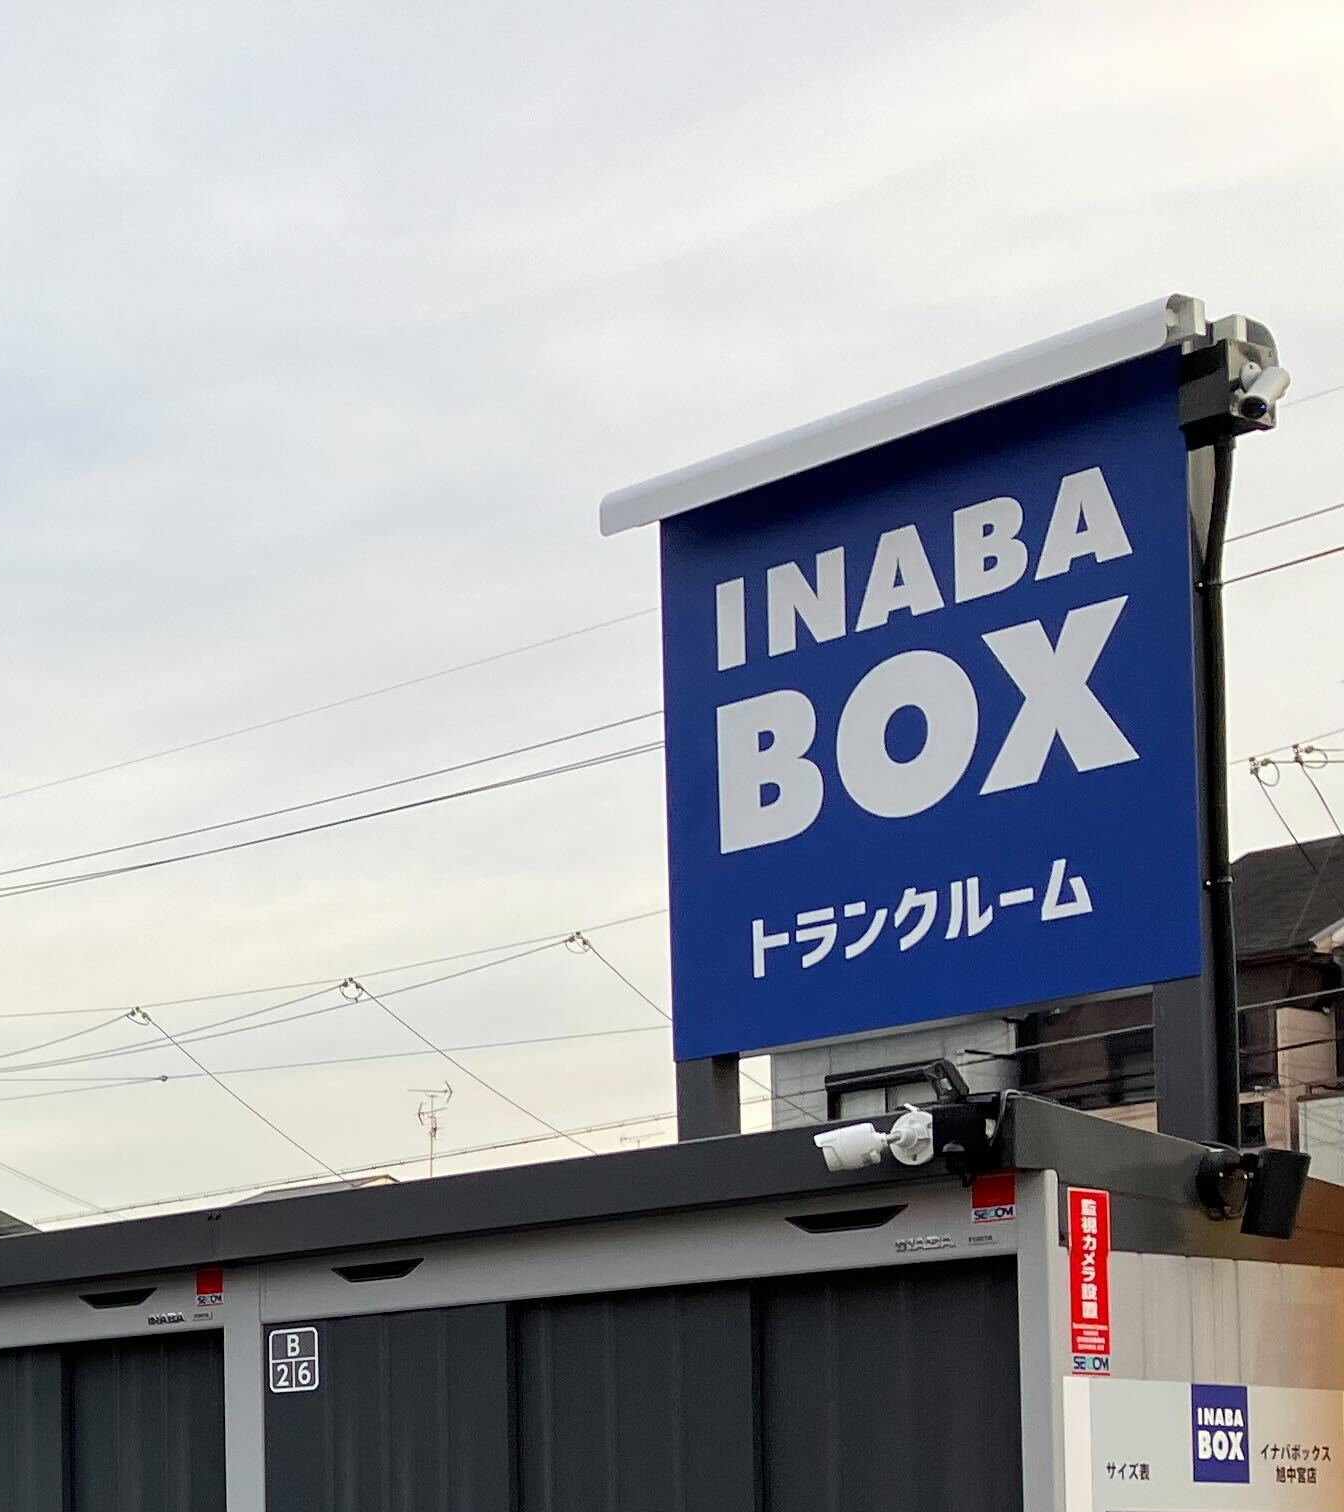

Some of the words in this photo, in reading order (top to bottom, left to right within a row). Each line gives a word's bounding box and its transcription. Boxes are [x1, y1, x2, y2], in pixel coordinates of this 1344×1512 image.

[715, 466, 1133, 672] INABA
[717, 595, 1140, 855] BOX
[752, 858, 1094, 979] トランクルーム
[974, 1205, 1014, 1220] SECOM
[286, 1333, 300, 1357] B
[276, 1362, 311, 1387] 26
[1073, 1356, 1110, 1371] SECOM
[1197, 1407, 1244, 1428] INABA
[1197, 1430, 1246, 1461] BOX
[1260, 1443, 1332, 1464] イナバボックス
[1105, 1462, 1151, 1482] サイズ表
[1275, 1465, 1317, 1485] 旭中宮店
